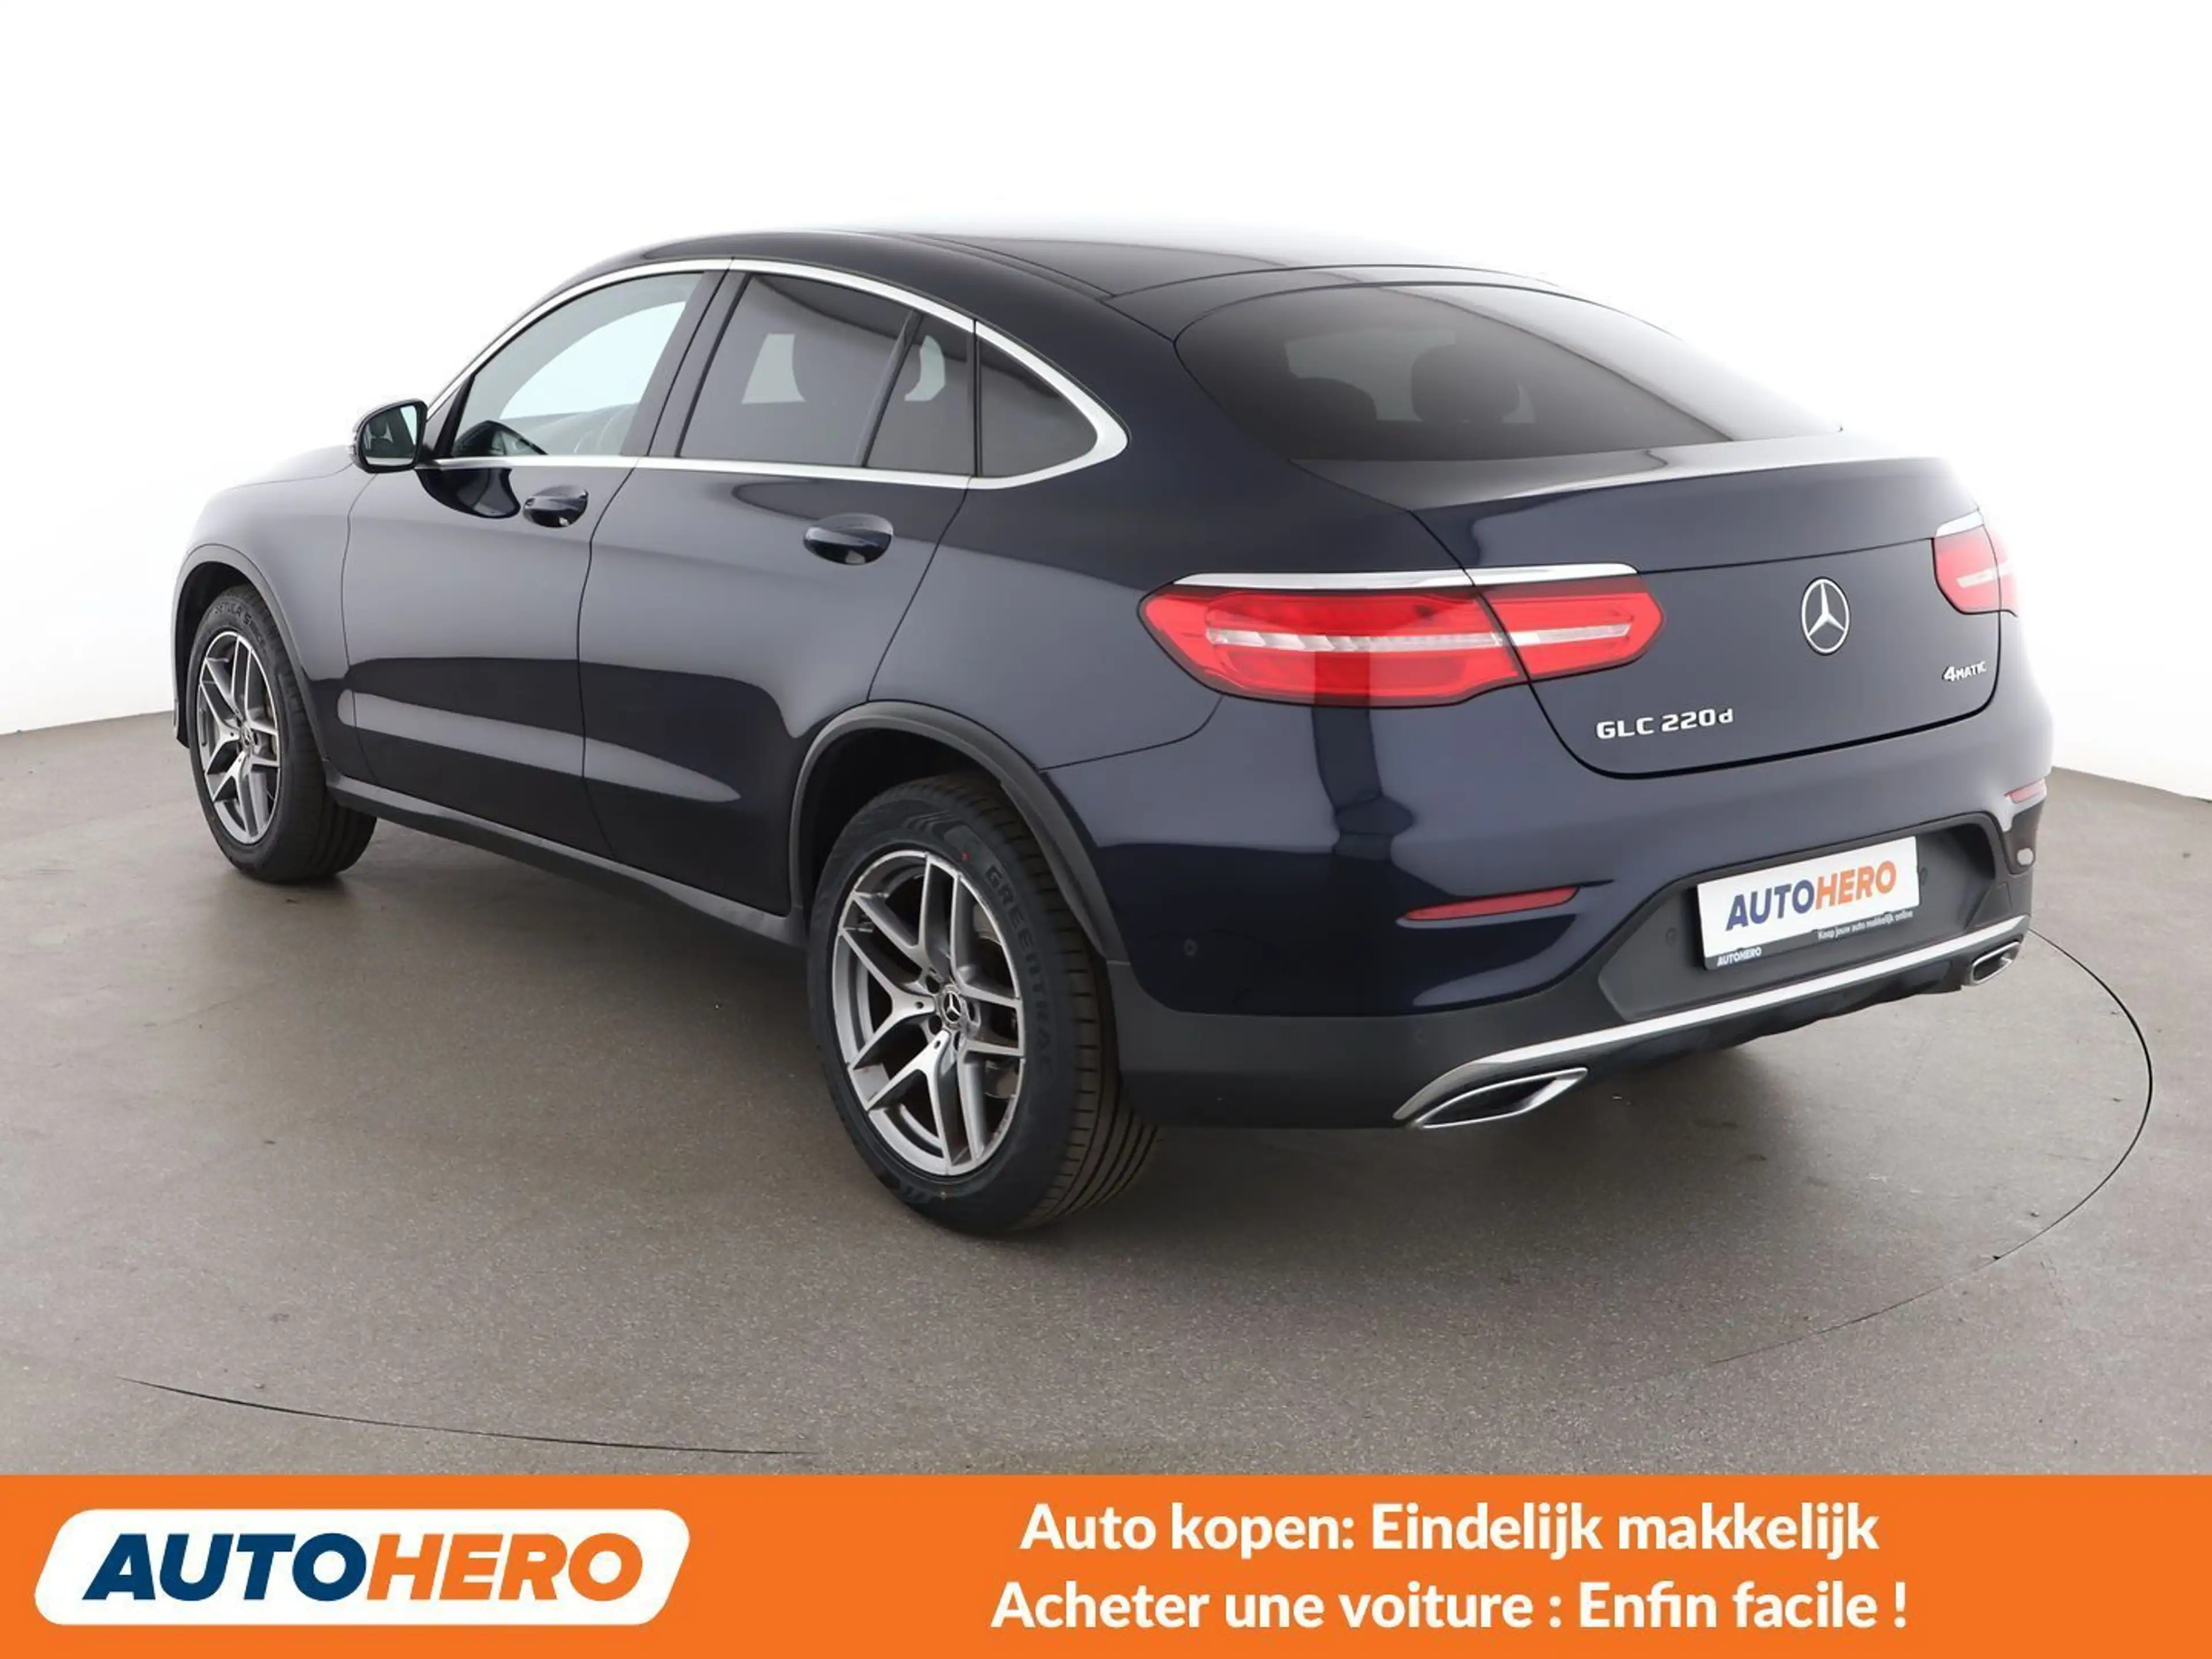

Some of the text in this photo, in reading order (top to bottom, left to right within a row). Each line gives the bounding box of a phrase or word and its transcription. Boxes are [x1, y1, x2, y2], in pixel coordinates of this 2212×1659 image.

[1943, 661, 1987, 681] 4MATIC
[1596, 717, 1654, 739] GLC
[1725, 860, 1897, 931] AUTOHERO
[1717, 946, 1762, 967] AUTOHERO
